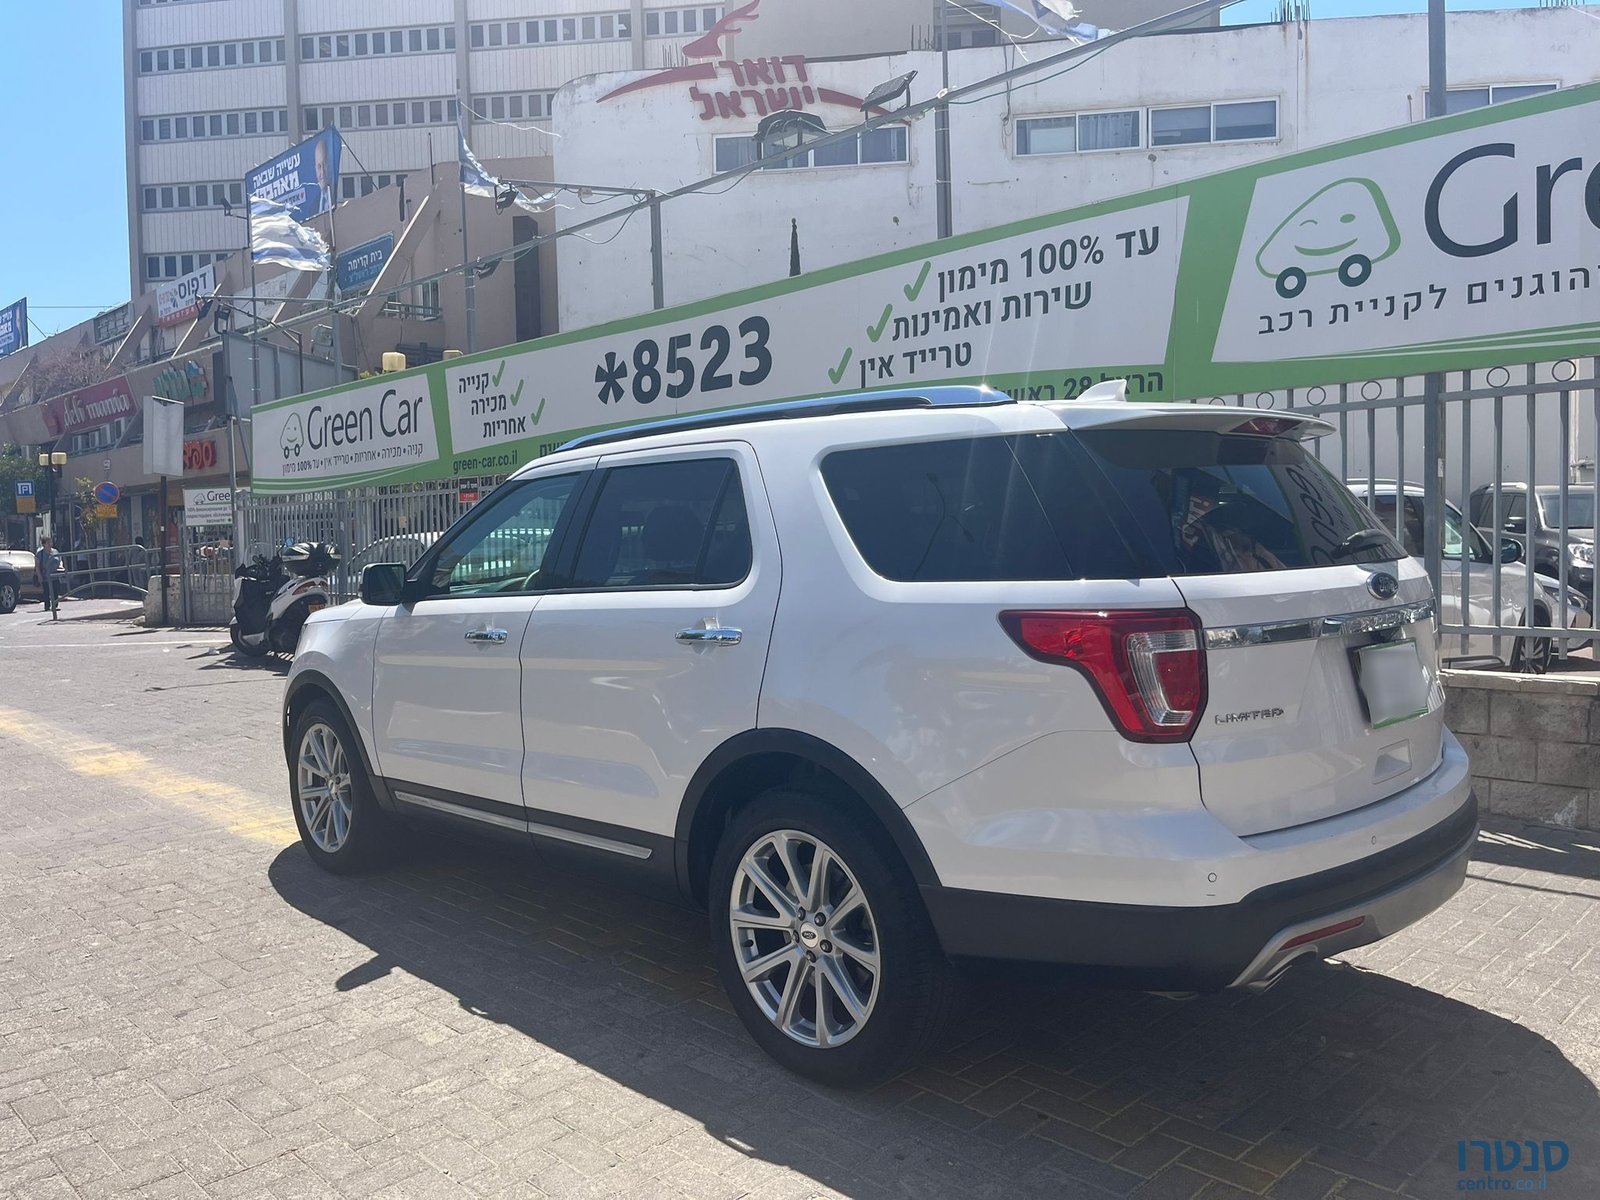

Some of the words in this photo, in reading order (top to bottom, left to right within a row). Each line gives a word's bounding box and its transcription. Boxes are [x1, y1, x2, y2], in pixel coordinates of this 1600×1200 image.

[719, 55, 808, 87] דואר
[689, 86, 815, 121] ישראל
[252, 166, 275, 190] שבאה
[275, 152, 301, 177] עשייה
[1424, 142, 1600, 258] Gr
[1116, 225, 1160, 259] עד
[347, 254, 369, 271] קדימה
[370, 250, 383, 263] בית
[1020, 234, 1104, 278] 100%
[178, 272, 207, 300] דפוס
[938, 258, 1009, 303] מימון
[1467, 264, 1600, 305] הוגנים
[1001, 280, 1092, 322] שירות
[1328, 284, 1447, 324] לקניית
[892, 300, 991, 341] ואמינות
[1258, 308, 1313, 335] רכב
[902, 341, 972, 374] טרייד
[458, 372, 490, 394] קנייה
[859, 355, 894, 389] אין
[1064, 375, 1092, 400] 28
[470, 393, 507, 416] מכירה
[307, 404, 372, 450] Green
[379, 389, 423, 438] Car
[483, 416, 526, 439] אחריות
[353, 449, 377, 463] אחריות
[381, 446, 402, 460] מכירה
[407, 443, 423, 458] קניה
[453, 449, 518, 475] green-car.co.il
[296, 460, 312, 472] 100%
[1214, 707, 1285, 725] LIMITED
